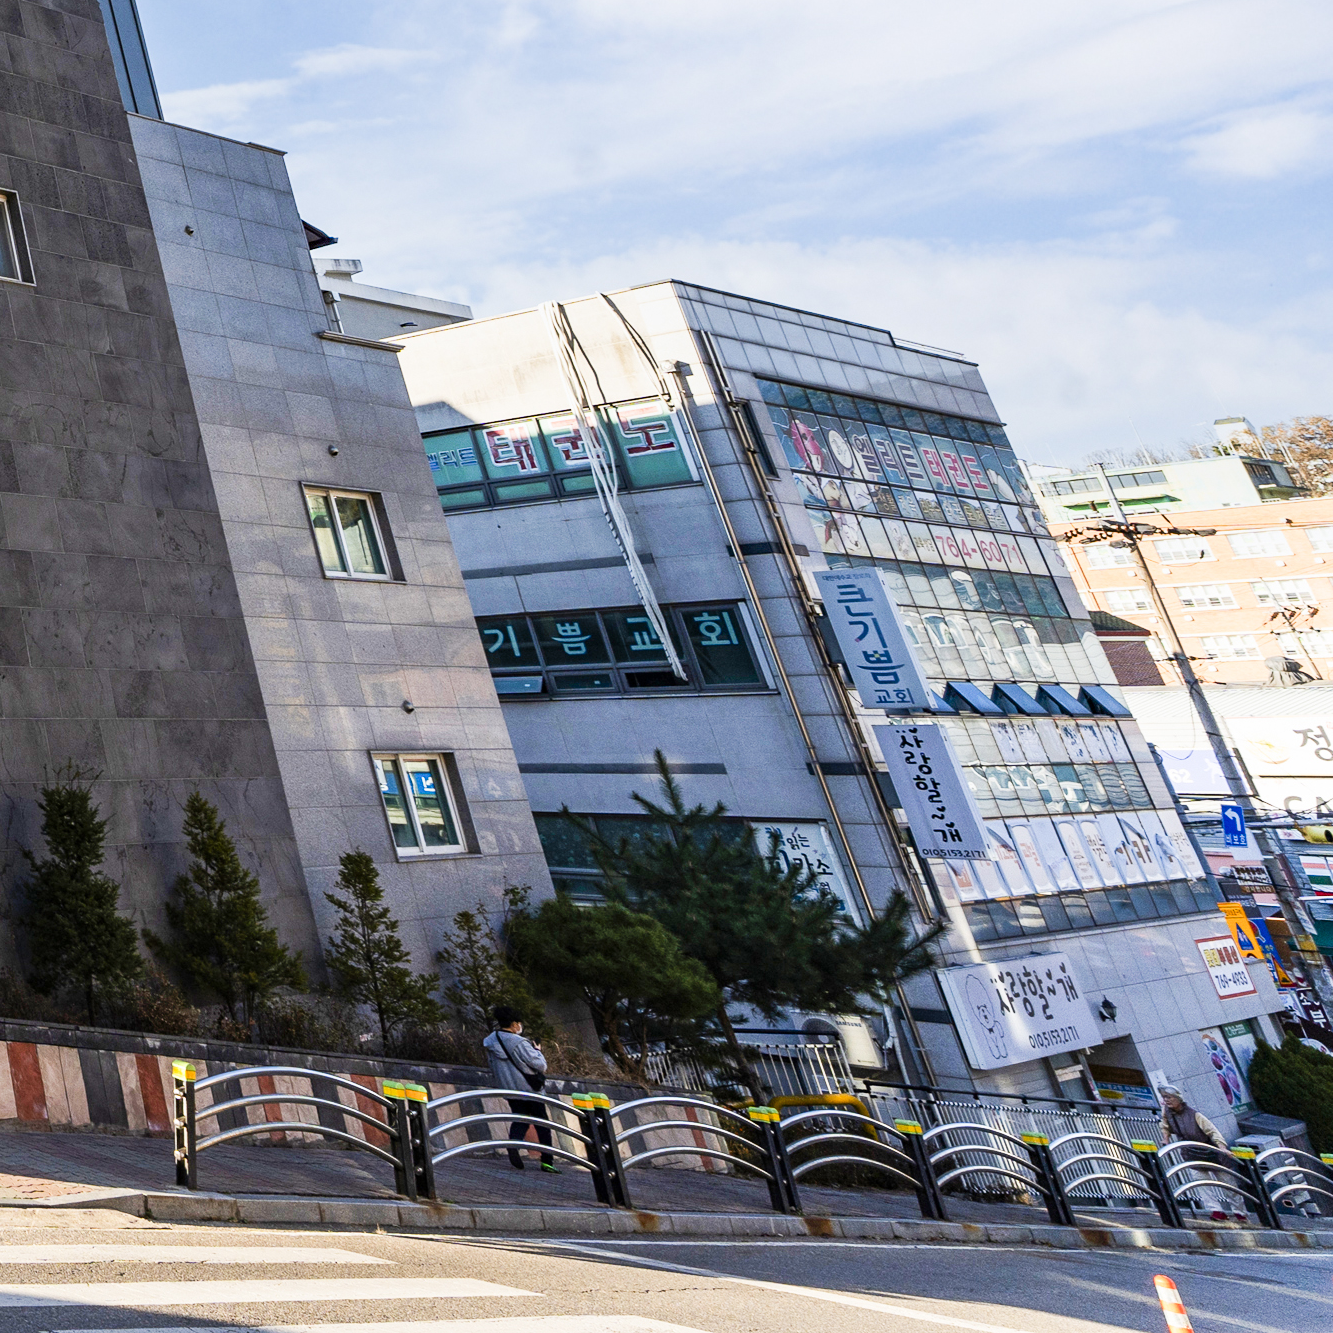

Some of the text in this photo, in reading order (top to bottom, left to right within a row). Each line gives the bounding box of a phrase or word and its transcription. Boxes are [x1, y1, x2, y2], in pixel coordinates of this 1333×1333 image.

[922, 447, 989, 490] 태권도
[935, 535, 1022, 565] 764-6071
[837, 584, 906, 685] 큰기쁨
[875, 688, 914, 704] 교회
[835, 1020, 862, 1028] SAMSUNG
